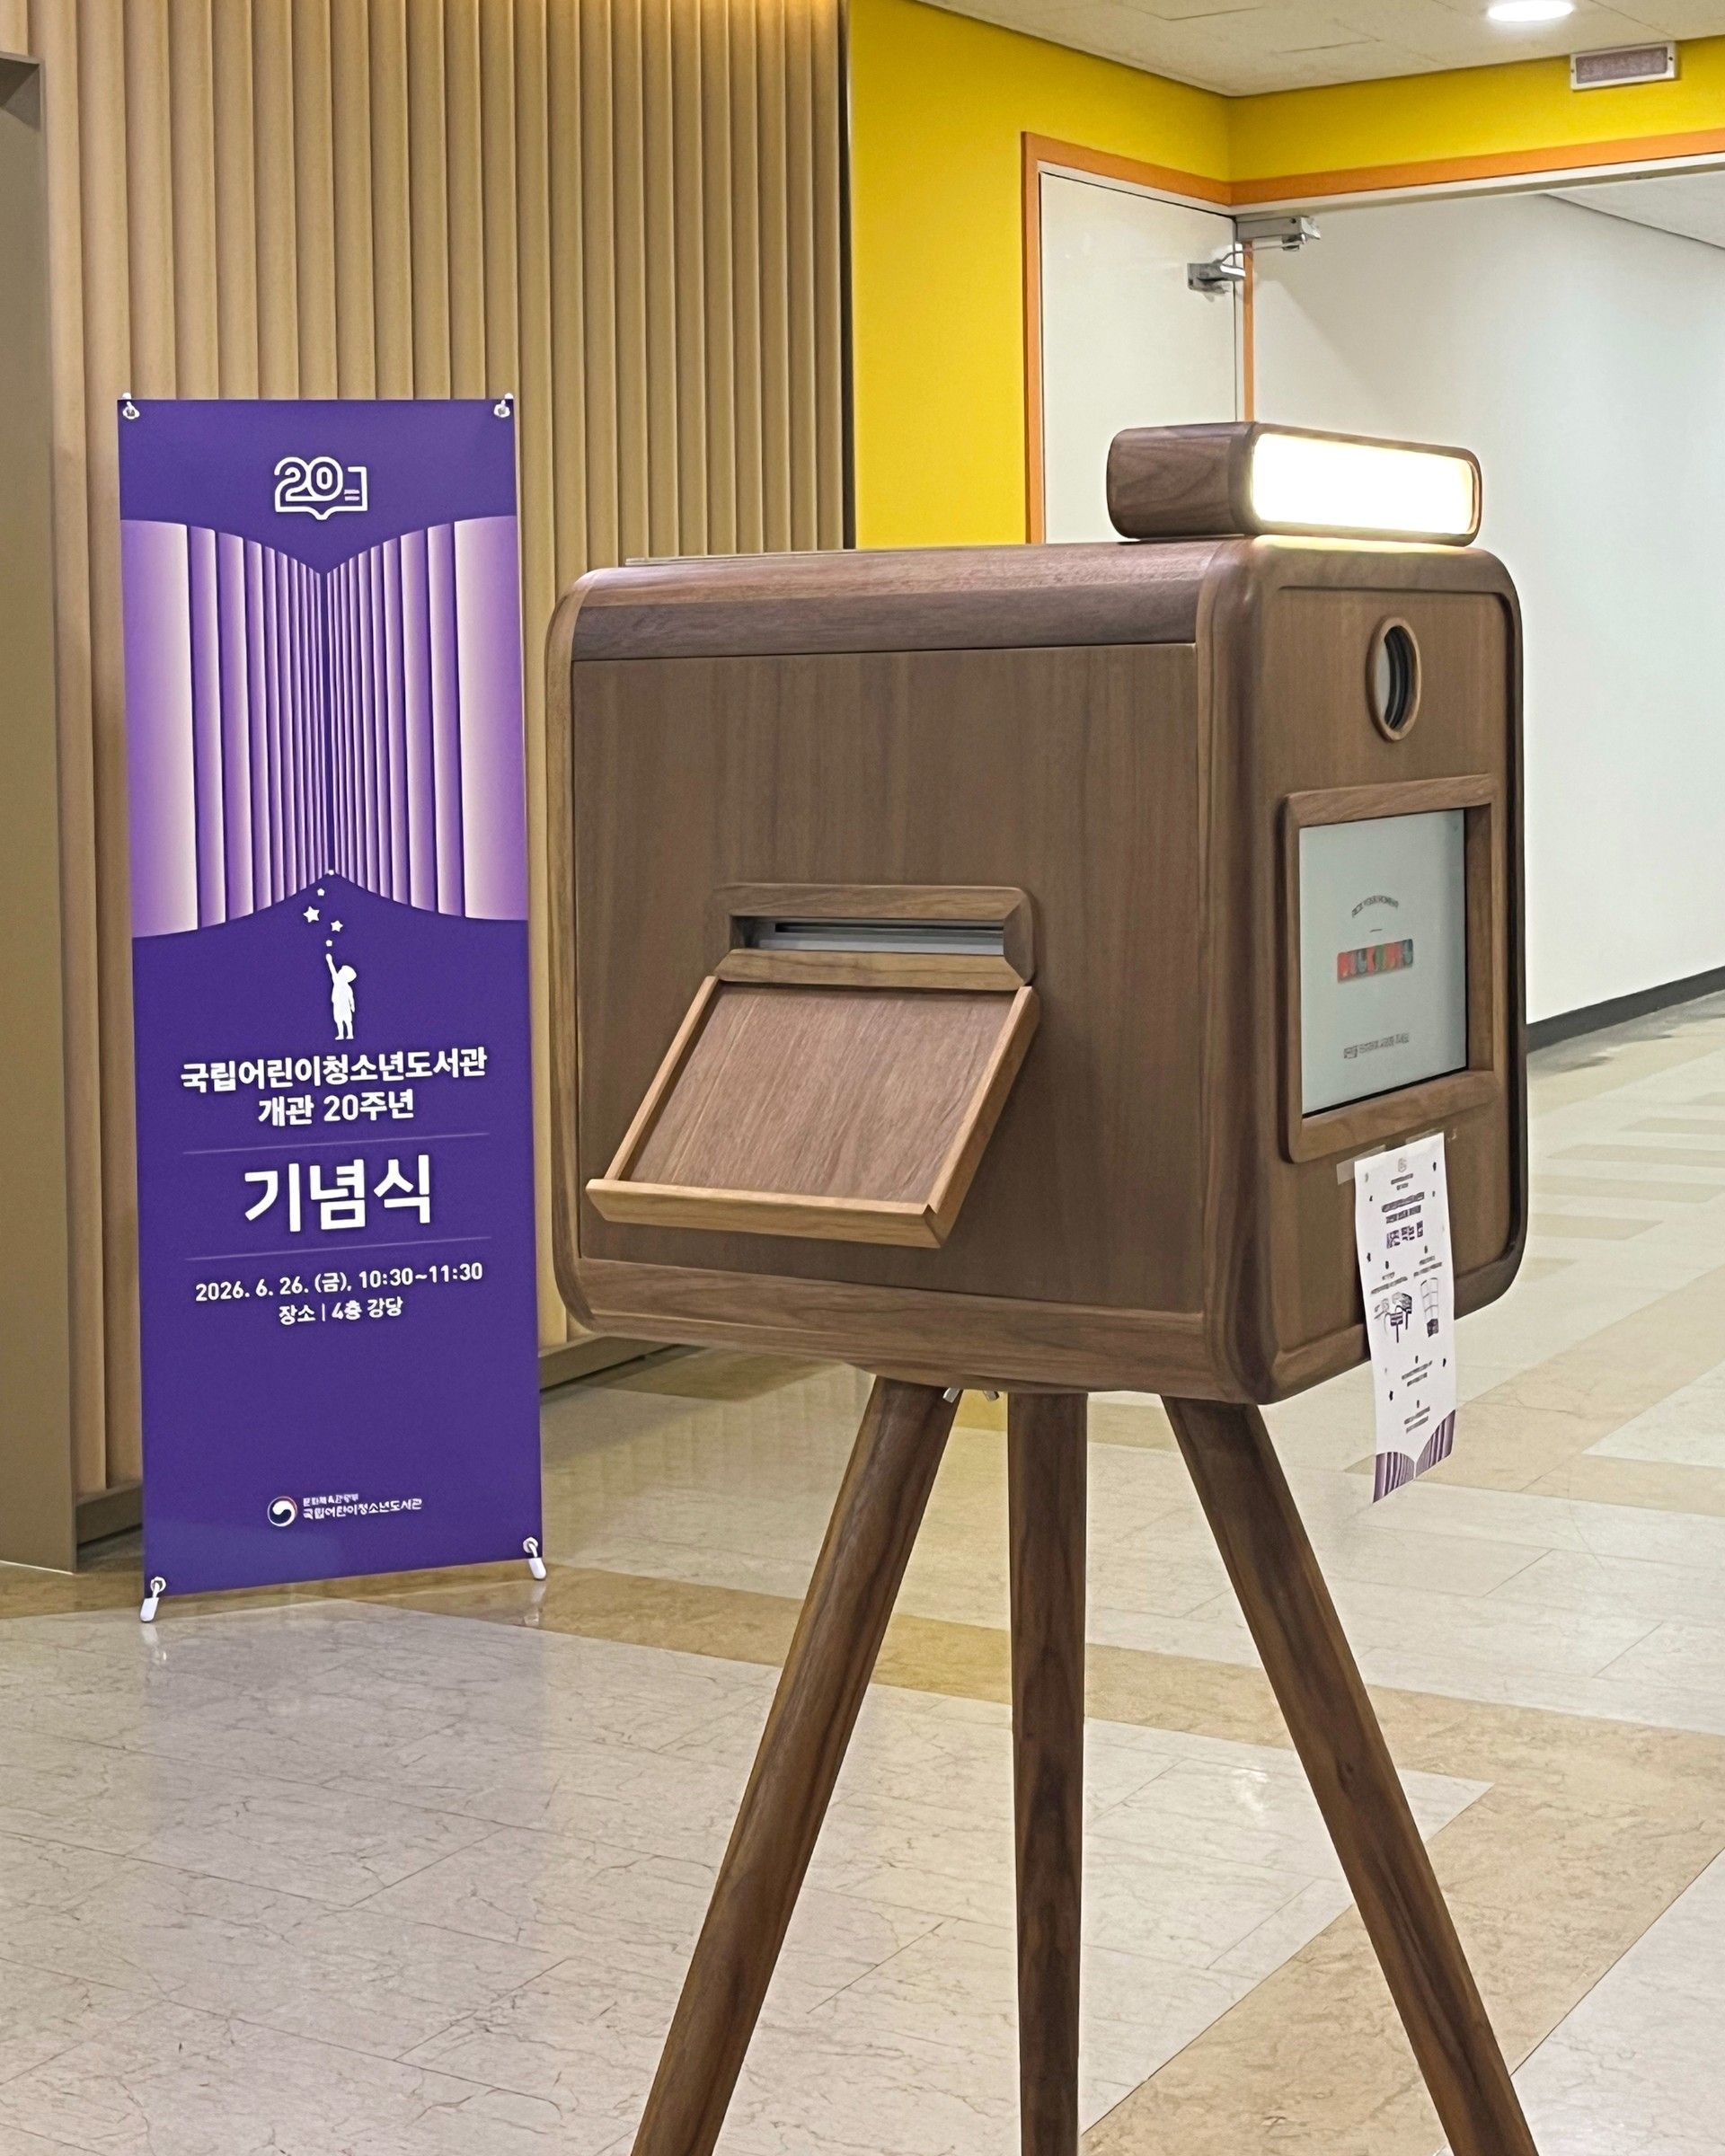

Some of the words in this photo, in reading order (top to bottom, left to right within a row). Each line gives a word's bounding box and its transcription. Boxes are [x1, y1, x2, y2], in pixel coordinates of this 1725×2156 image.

[181, 1046, 488, 1093] 국립어린이청소년도서관
[258, 1094, 314, 1127] 개관
[323, 1088, 414, 1122] 20주년
[244, 1154, 430, 1233] 기념식
[195, 1280, 251, 1302] 2026.
[255, 1278, 274, 1297] 6.
[279, 1276, 309, 1295] 26.
[314, 1271, 352, 1294] (금),
[358, 1262, 483, 1289] 10:30~11:30
[279, 1304, 316, 1326] 장소
[331, 1299, 363, 1321] 4층
[367, 1295, 403, 1318] 강당
